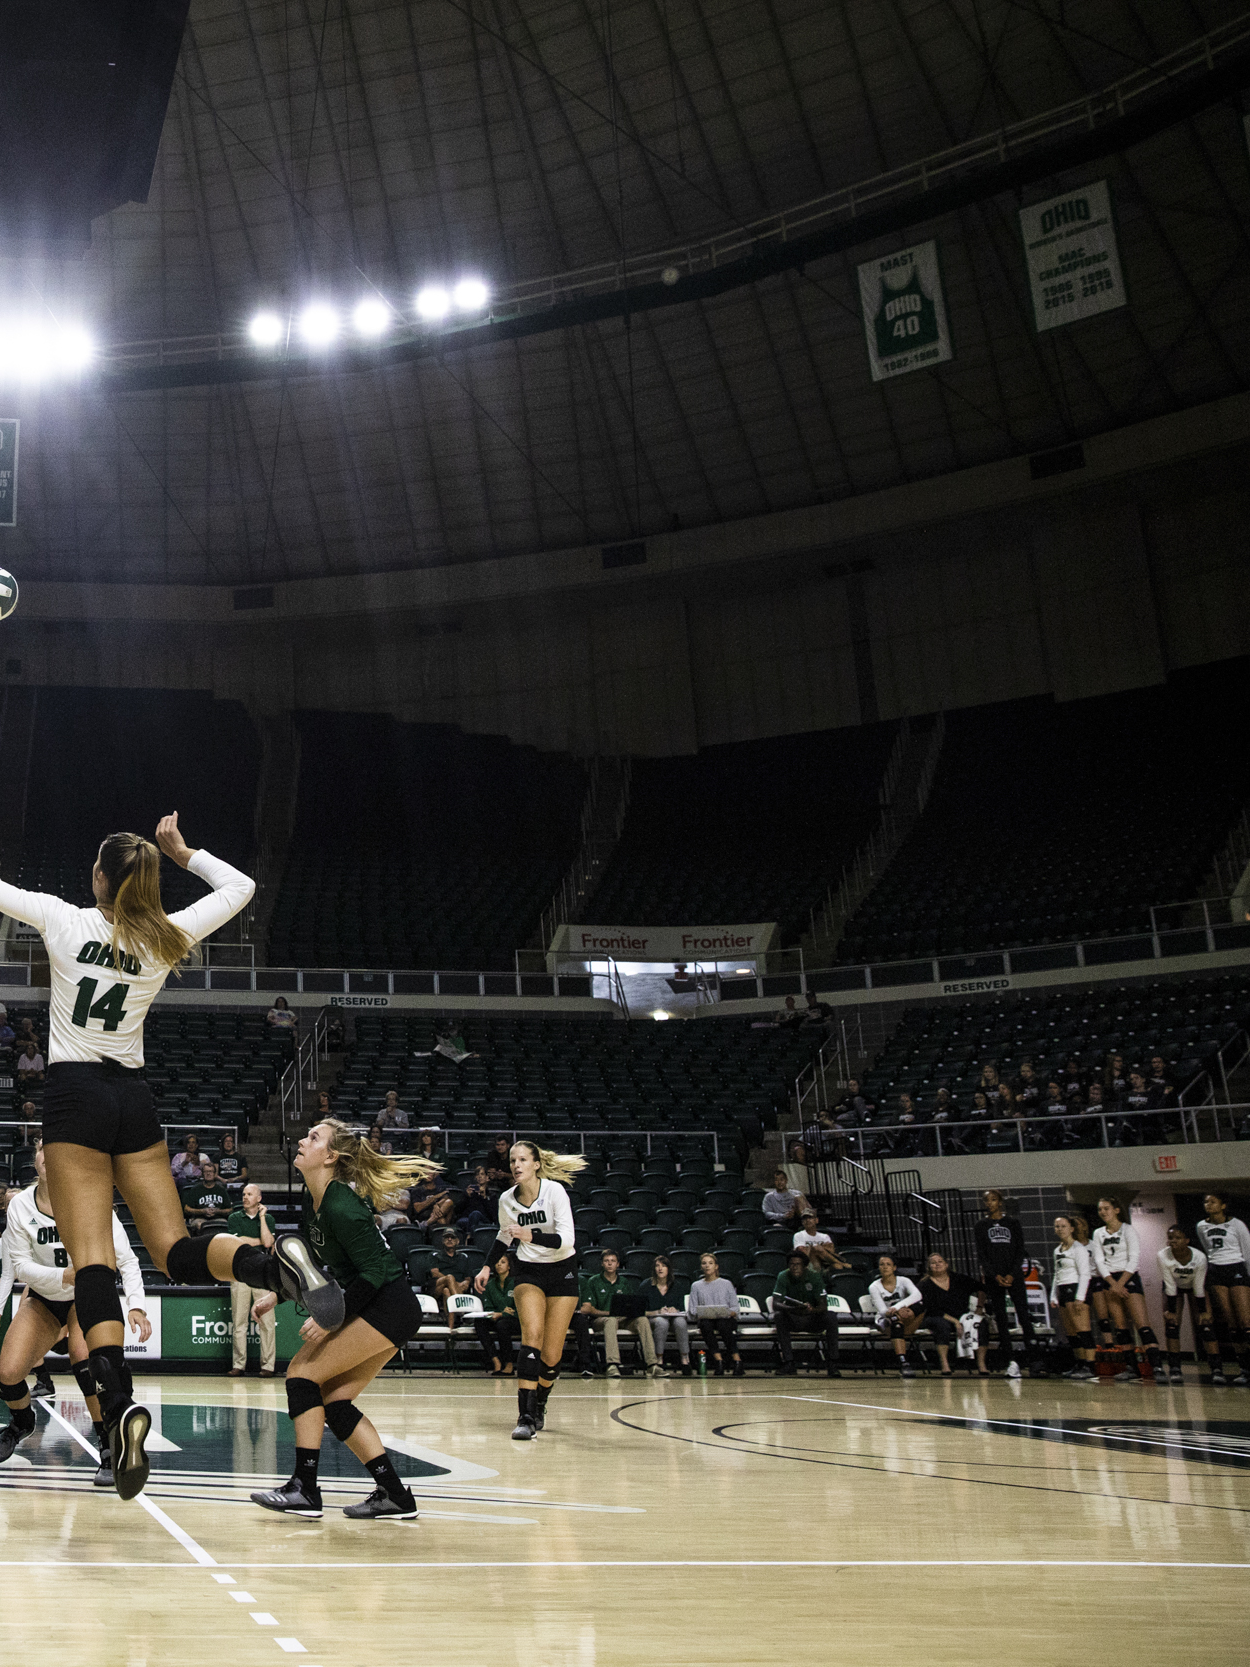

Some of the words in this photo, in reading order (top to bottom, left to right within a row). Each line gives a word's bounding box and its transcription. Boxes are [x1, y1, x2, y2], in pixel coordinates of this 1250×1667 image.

[1041, 198, 1091, 235] OHIO
[879, 252, 914, 272] MAST
[1039, 251, 1109, 281] CHAMPIONS
[885, 294, 922, 321] OHIO
[893, 316, 920, 338] 40
[581, 933, 648, 950] Frontier
[682, 934, 754, 949] Frontier
[76, 941, 142, 976] OHIO
[944, 980, 1010, 993] RESERVED
[72, 976, 130, 1031] 14
[330, 997, 388, 1006] RESERVED
[1158, 1156, 1177, 1169] EXIT
[199, 1194, 223, 1205] OHIO
[517, 1210, 547, 1227] OHIO
[37, 1226, 57, 1245] OH
[988, 1226, 1011, 1239] OHIO
[1212, 1238, 1224, 1249] 19
[54, 1248, 68, 1268] 8
[455, 1297, 475, 1308] OHIO
[738, 1298, 751, 1308] HIO
[827, 1296, 840, 1307] HIO
[123, 1344, 147, 1352] cations
